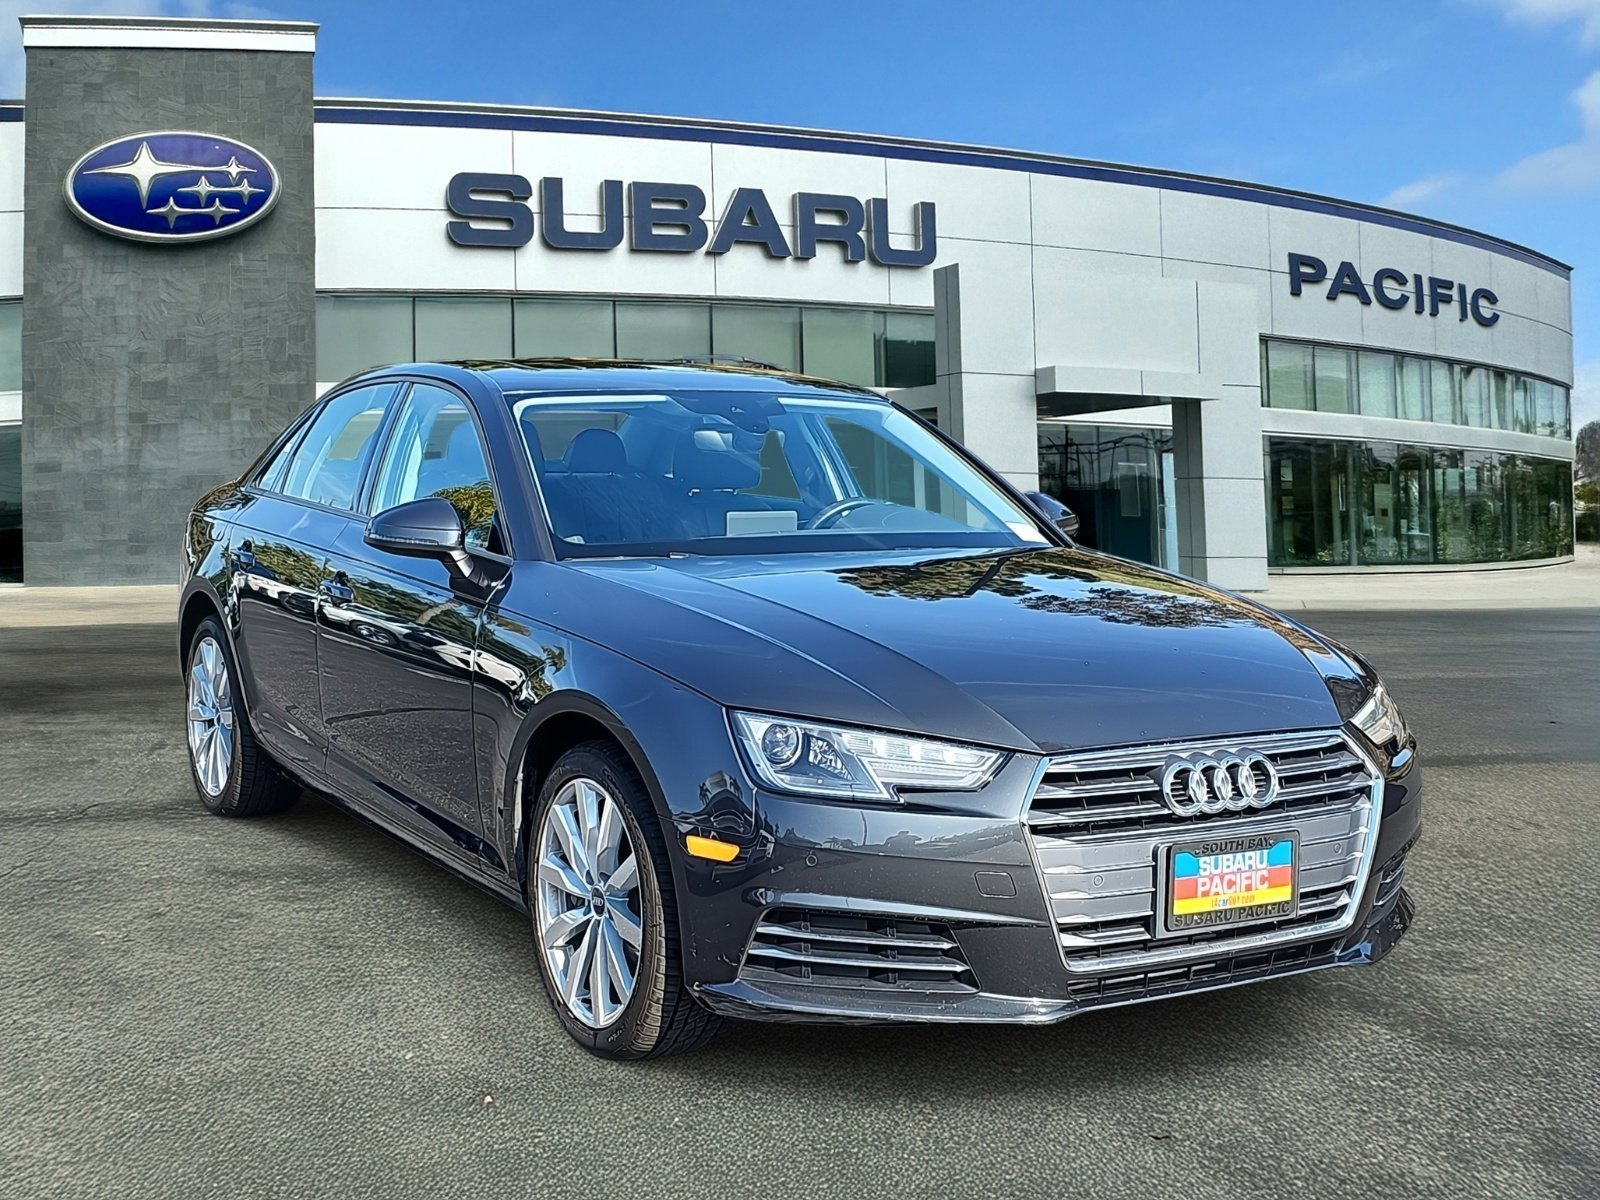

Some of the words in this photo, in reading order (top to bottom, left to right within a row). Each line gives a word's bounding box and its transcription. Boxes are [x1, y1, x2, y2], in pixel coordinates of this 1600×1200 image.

[446, 172, 937, 268] SUBARU
[1288, 252, 1500, 327] PACIFIC
[1201, 840, 1245, 854] SOUTH
[1248, 836, 1270, 849] BAY
[1198, 850, 1268, 876] SUBARU
[1197, 870, 1268, 897] PACIFIC
[1174, 909, 1233, 927] SUBARU
[1239, 901, 1290, 919] PACIFIC
